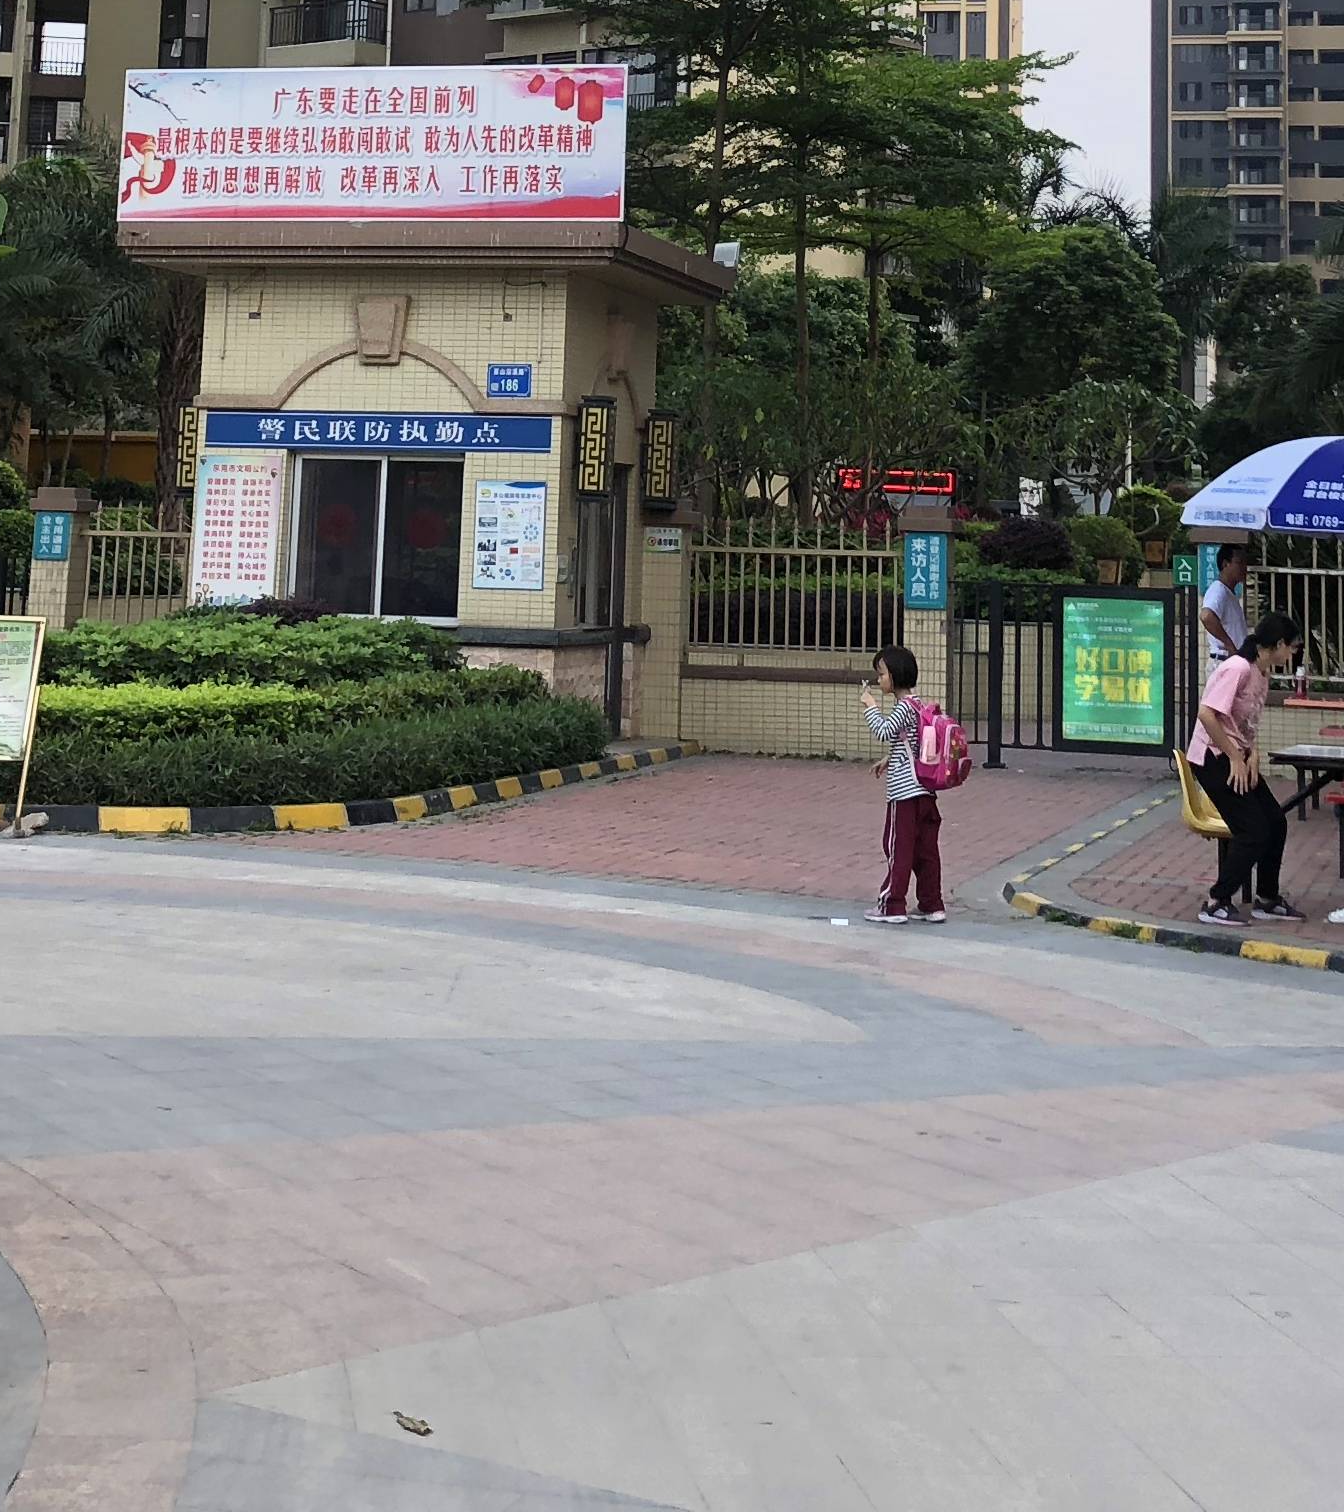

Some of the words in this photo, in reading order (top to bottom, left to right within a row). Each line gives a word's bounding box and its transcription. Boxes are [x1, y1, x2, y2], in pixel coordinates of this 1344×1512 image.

[272, 85, 478, 117] 广东要走在全国前列
[156, 124, 413, 156] 最根本的是要继续弘扬敢闯敢试
[424, 124, 594, 155] 敢为人先的改革精神
[181, 165, 323, 197] 推动思想再解放
[339, 164, 440, 195] 改革再深入
[459, 163, 564, 195] 工作再落实
[501, 378, 520, 392] 186
[257, 417, 501, 444] 警民联防执勤点
[911, 537, 927, 597] 来访人员
[1178, 557, 1193, 583] 入口
